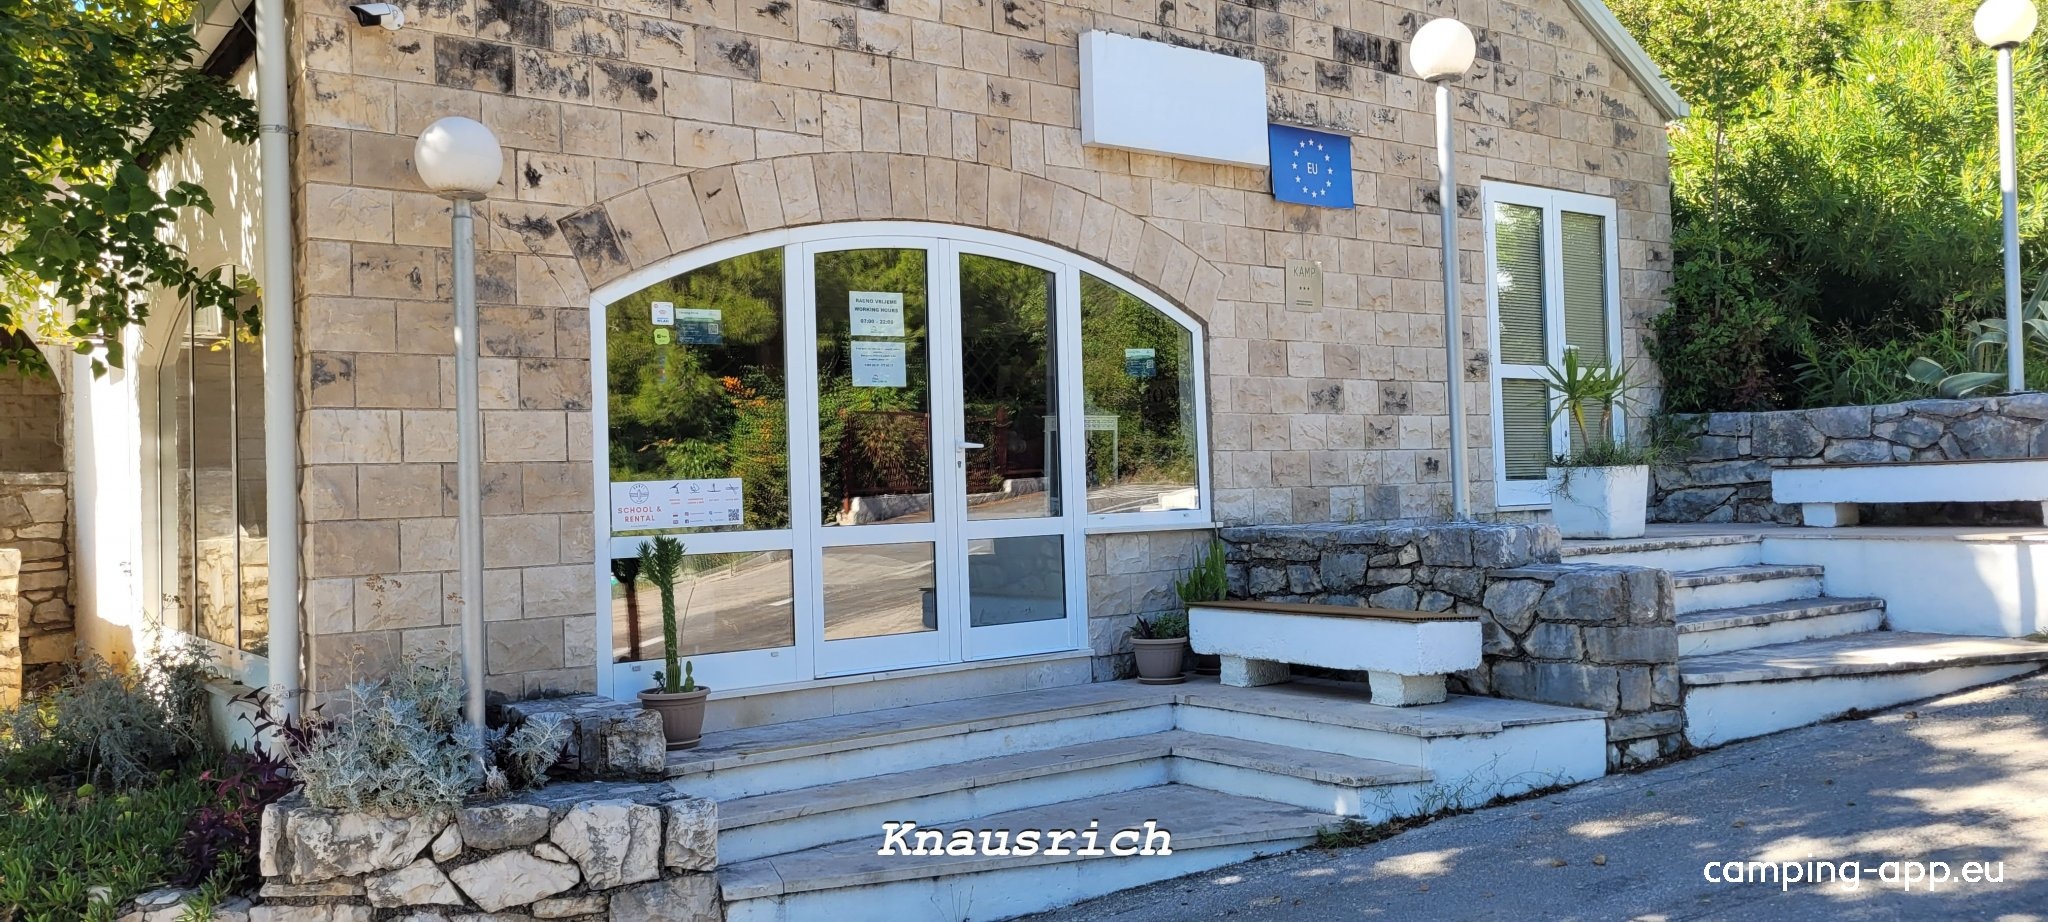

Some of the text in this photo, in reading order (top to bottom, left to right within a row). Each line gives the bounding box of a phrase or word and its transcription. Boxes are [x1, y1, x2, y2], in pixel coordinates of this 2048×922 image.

[1307, 162, 1318, 175] EU
[1293, 266, 1316, 278] KAMP
[617, 506, 653, 514] SCHOOL
[624, 515, 656, 523] RENTAL
